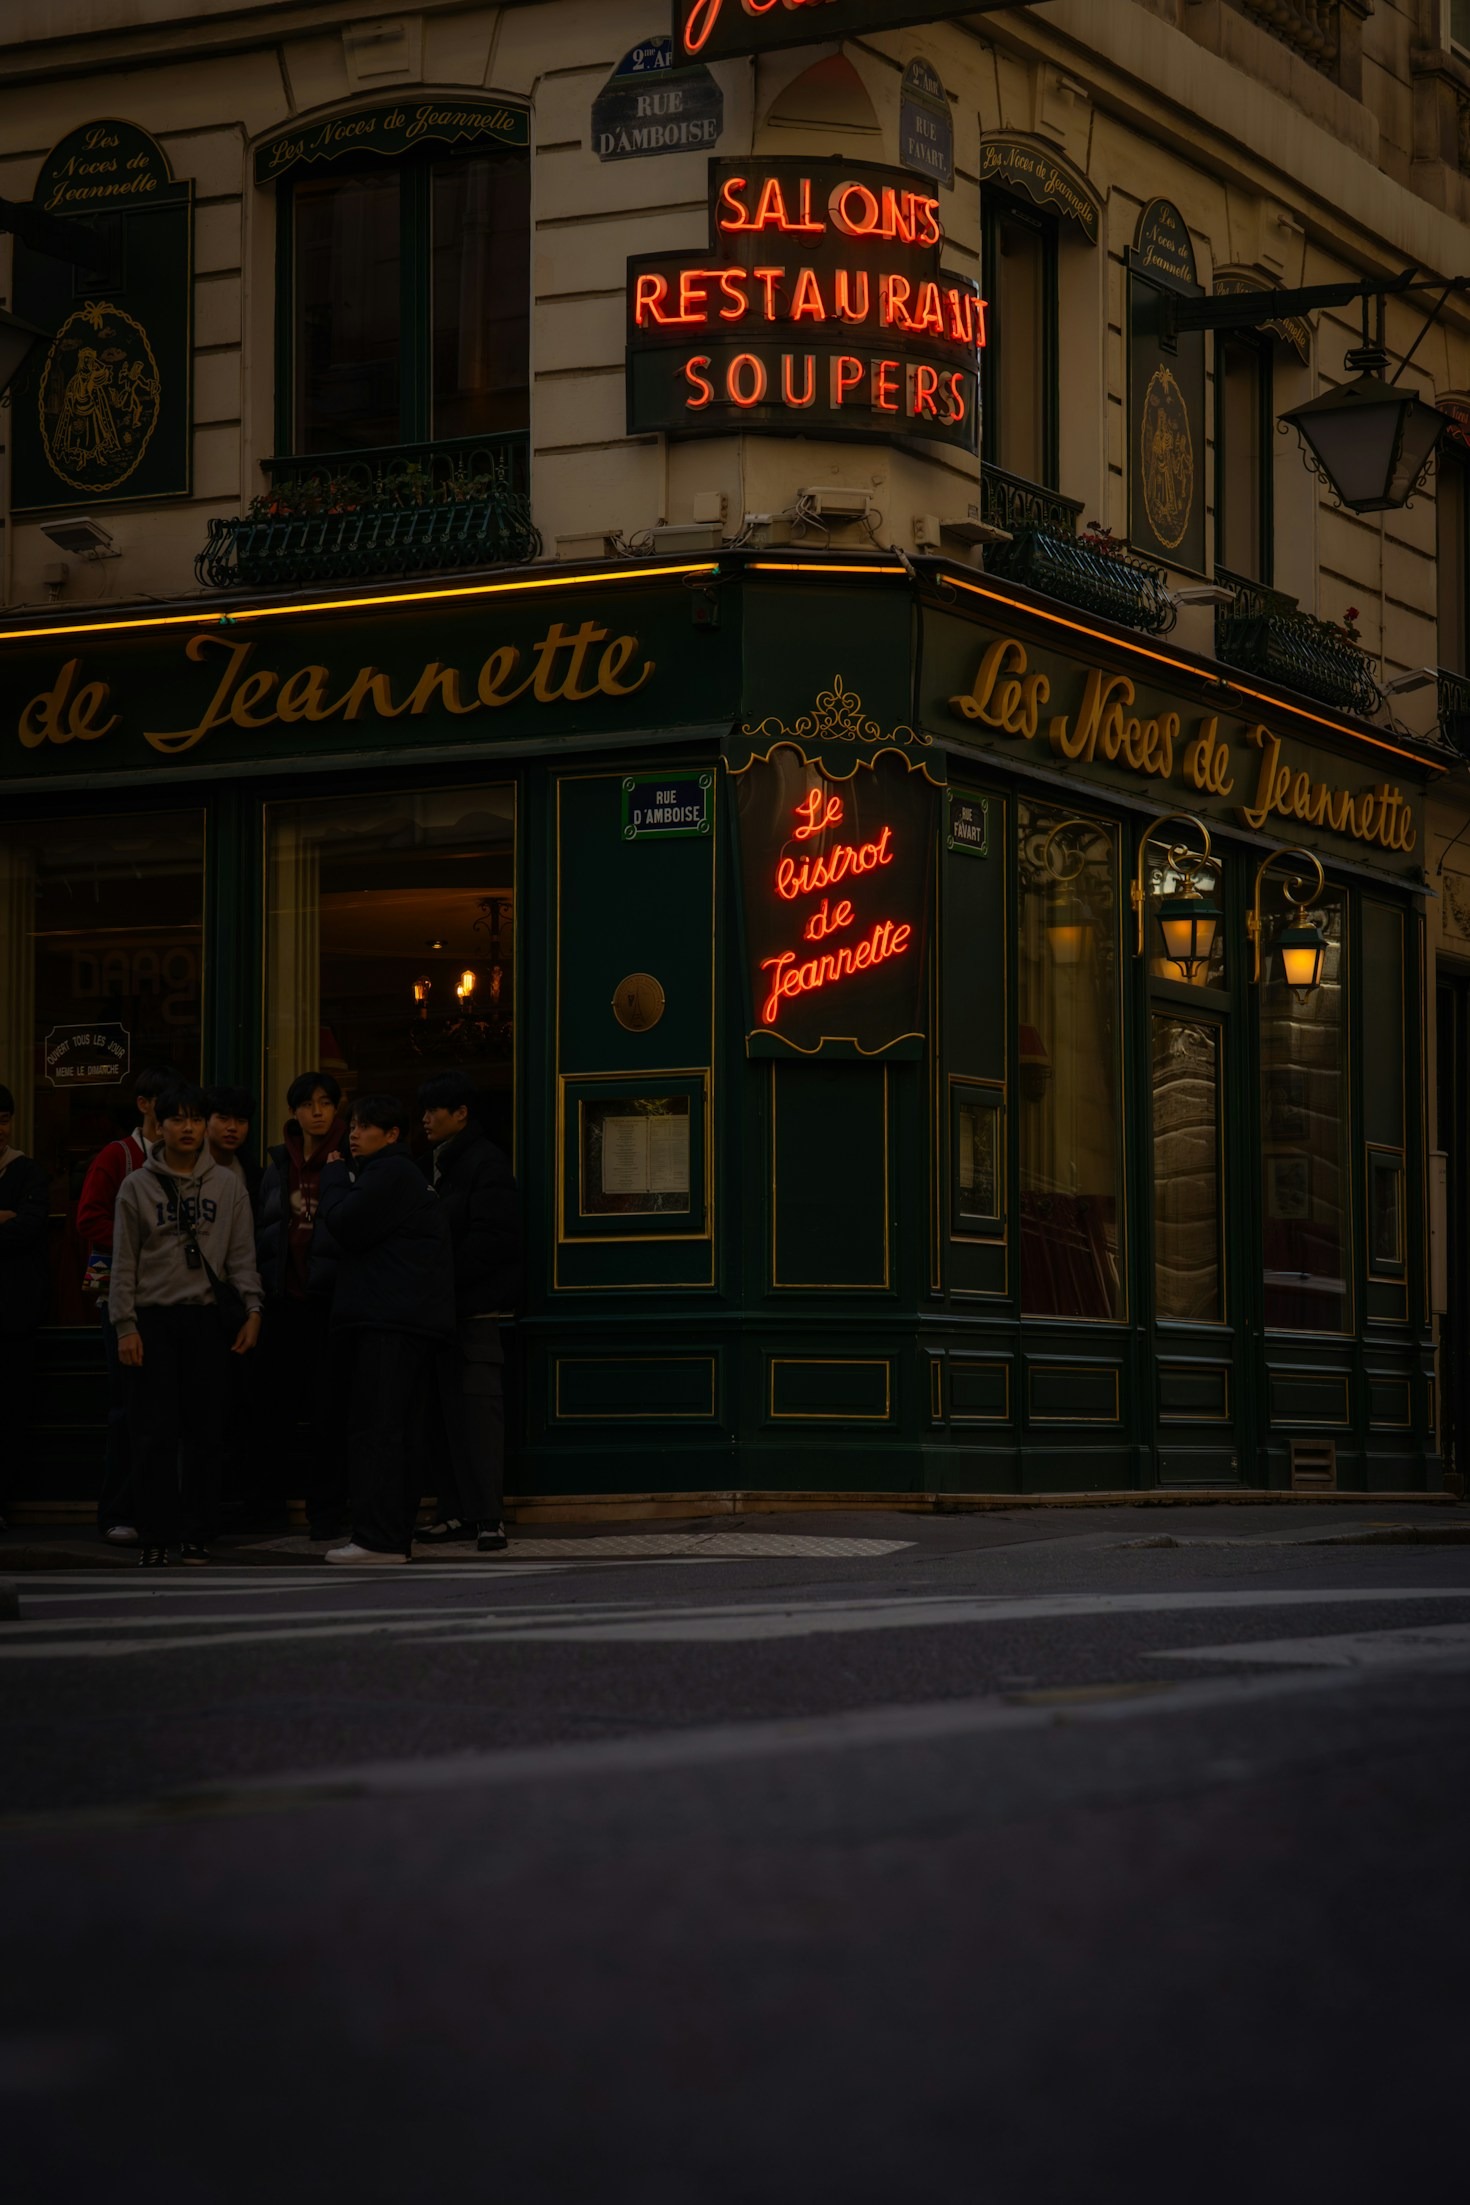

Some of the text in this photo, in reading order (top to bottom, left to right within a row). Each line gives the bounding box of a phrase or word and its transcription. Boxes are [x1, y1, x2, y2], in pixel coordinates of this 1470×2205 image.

[636, 91, 684, 118] RUE
[82, 127, 121, 151] Les
[268, 104, 516, 168] Les Noces de Jeannette
[600, 118, 717, 155] D'AMBOISE
[916, 115, 937, 141] RUE
[52, 151, 151, 179] Noces de
[43, 172, 158, 211] Jeannette
[983, 146, 1094, 225] Les Noces de Jeannette
[720, 176, 941, 246] SALONS
[1146, 224, 1189, 259] Noces de
[1142, 244, 1192, 283] Jeannette
[635, 265, 989, 349] RESTAURANT
[683, 353, 967, 426] SOUPERS
[18, 620, 657, 755] de Jeannette
[948, 638, 1418, 854] Les Noces de Jeannette
[656, 789, 677, 805] RUE
[794, 787, 844, 839] Le
[961, 806, 974, 822] RUE
[953, 822, 982, 842] FAVART
[775, 826, 894, 899] bistrot
[804, 897, 856, 941] de
[760, 919, 912, 1024] Jeannette
[47, 1039, 70, 1065] OUVERT
[72, 1033, 91, 1048] TOUS
[93, 1034, 106, 1047] LES
[76, 1066, 86, 1076] LE
[87, 1064, 120, 1075] DIMANCHE
